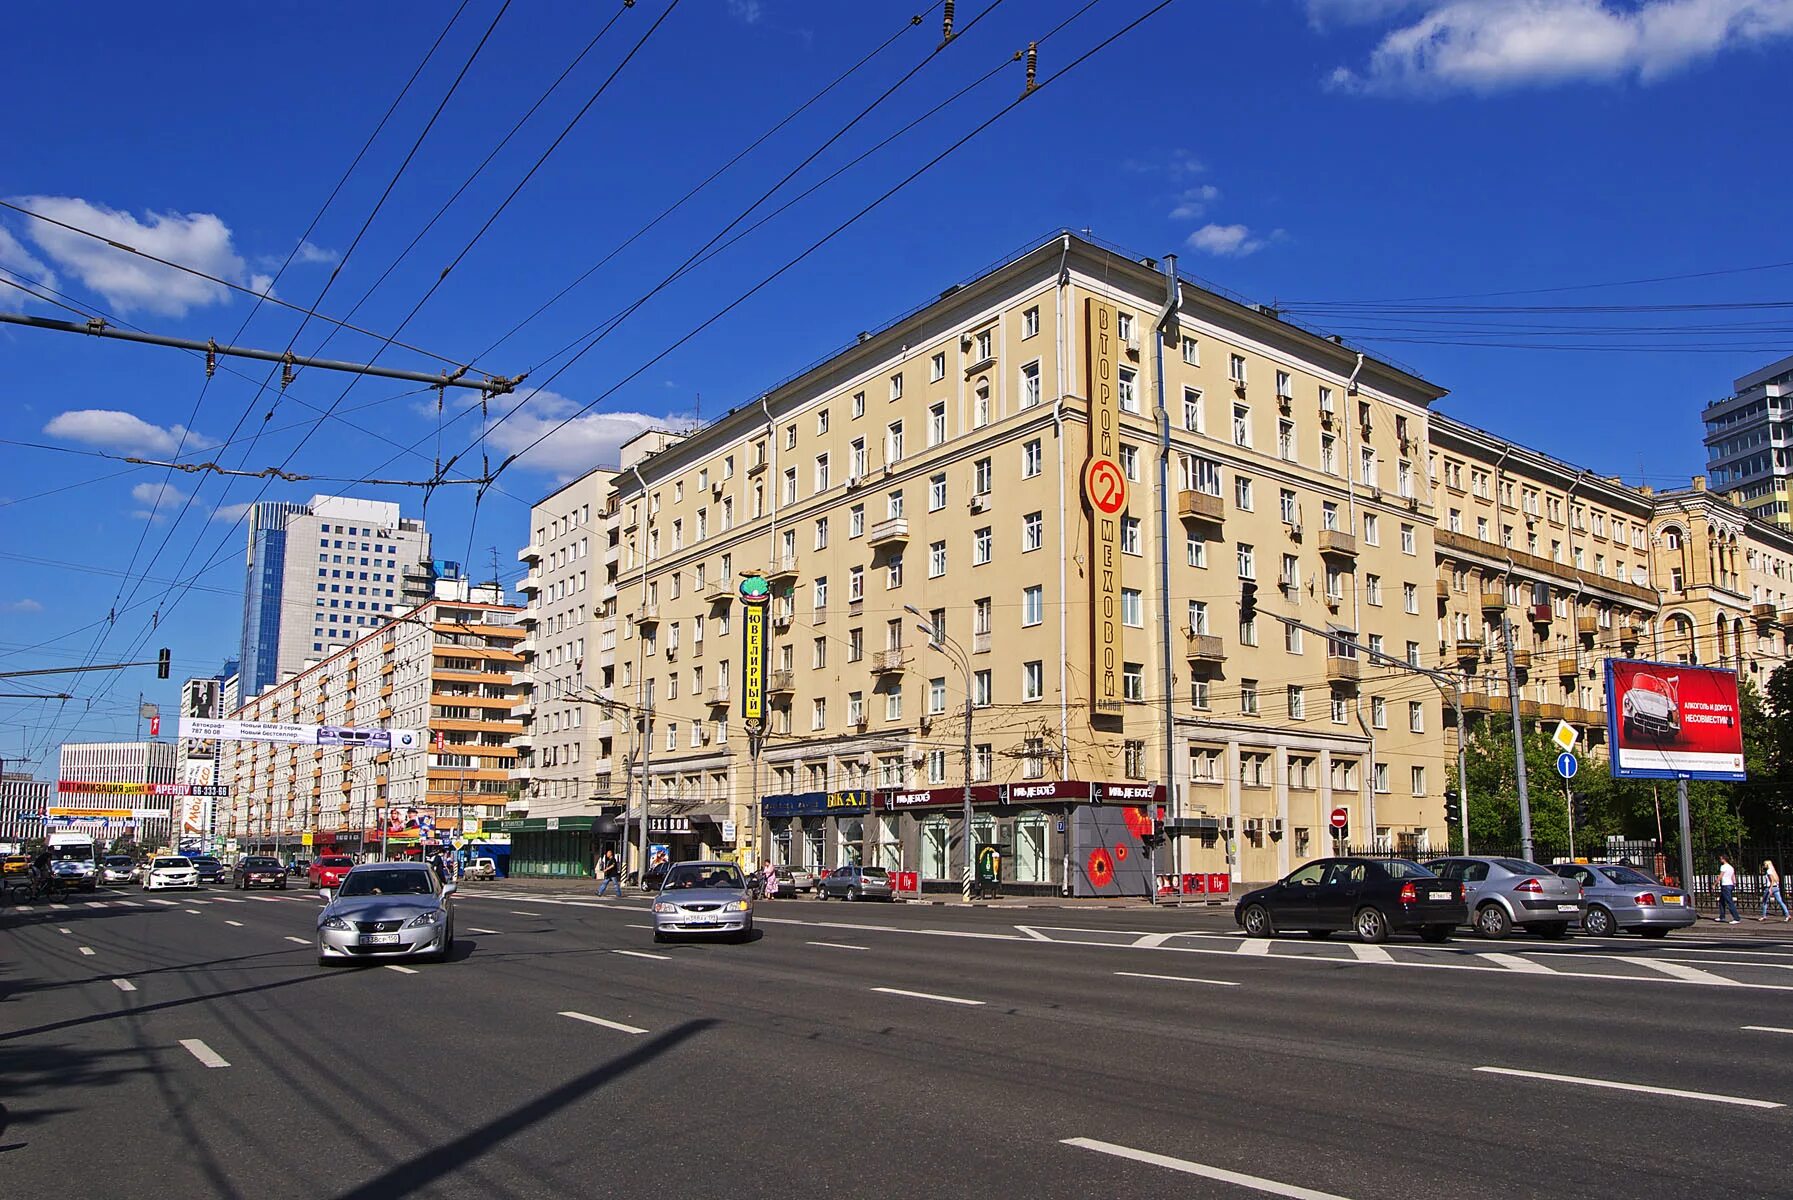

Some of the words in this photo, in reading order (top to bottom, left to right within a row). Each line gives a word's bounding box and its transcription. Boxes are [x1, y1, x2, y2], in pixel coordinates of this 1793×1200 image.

[1099, 308, 1112, 457] ВТОРОЙ
[1101, 519, 1115, 697] МЕХОВОЙ
[749, 614, 761, 710] ЮВЕЛИРНЫЙ
[1684, 701, 1709, 710] АЛКОГОЛЬ
[1714, 704, 1732, 712] ДОРОГА
[60, 782, 123, 793] ОПТИМИЗАЦИЯ
[125, 785, 144, 793] ЗАТРАТ
[156, 785, 190, 795] АРЕНДУ
